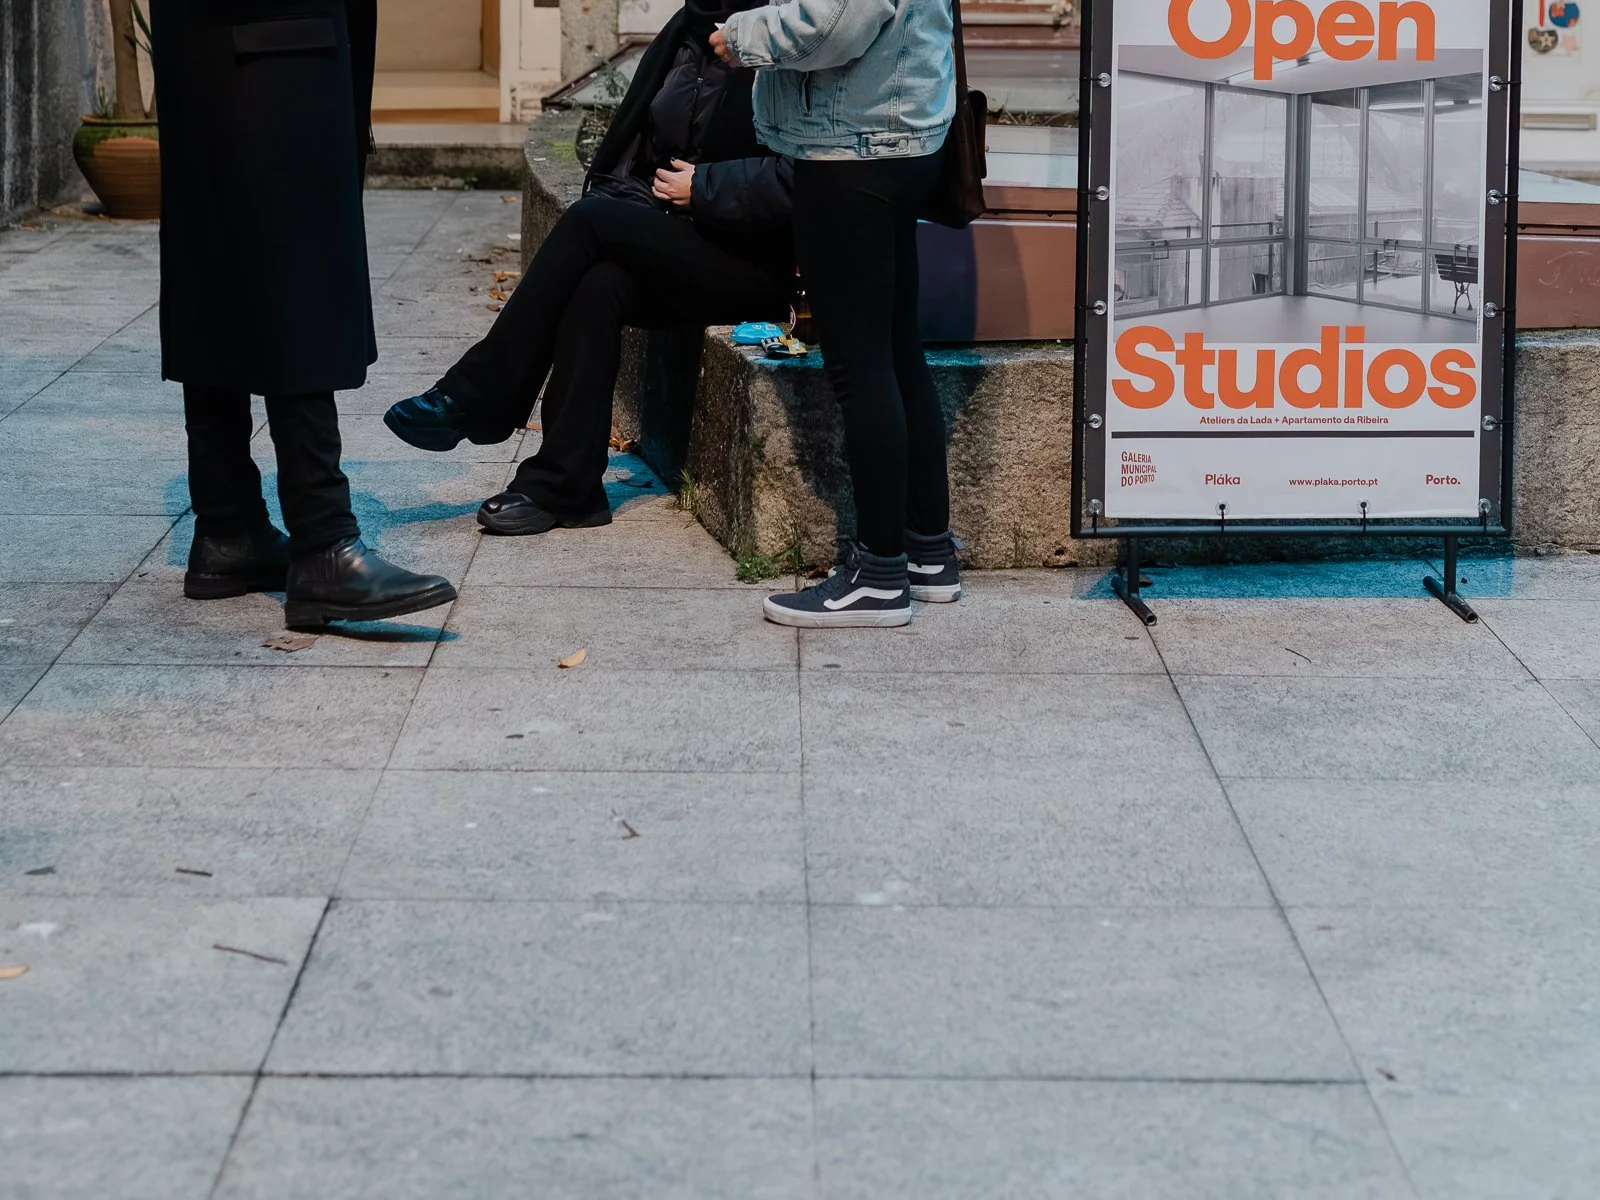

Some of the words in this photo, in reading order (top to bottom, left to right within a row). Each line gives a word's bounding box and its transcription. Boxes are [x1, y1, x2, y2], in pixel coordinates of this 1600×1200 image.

[1111, 325, 1478, 410] Studios
[1199, 416, 1236, 425] Ateliers
[1237, 416, 1249, 425] da
[1250, 416, 1273, 425] Lada
[1281, 416, 1342, 425] Apartamento
[1343, 416, 1356, 424] da
[1357, 415, 1389, 424] Ribeira
[1121, 451, 1152, 463] GALERIA
[1121, 463, 1157, 475] MUNICIPAL
[1121, 476, 1134, 487] DO
[1134, 474, 1155, 485] PORTO
[1204, 473, 1241, 486] Pláka
[1289, 478, 1379, 487] www.plaka.porto.pt
[1425, 474, 1461, 485] Porto.
